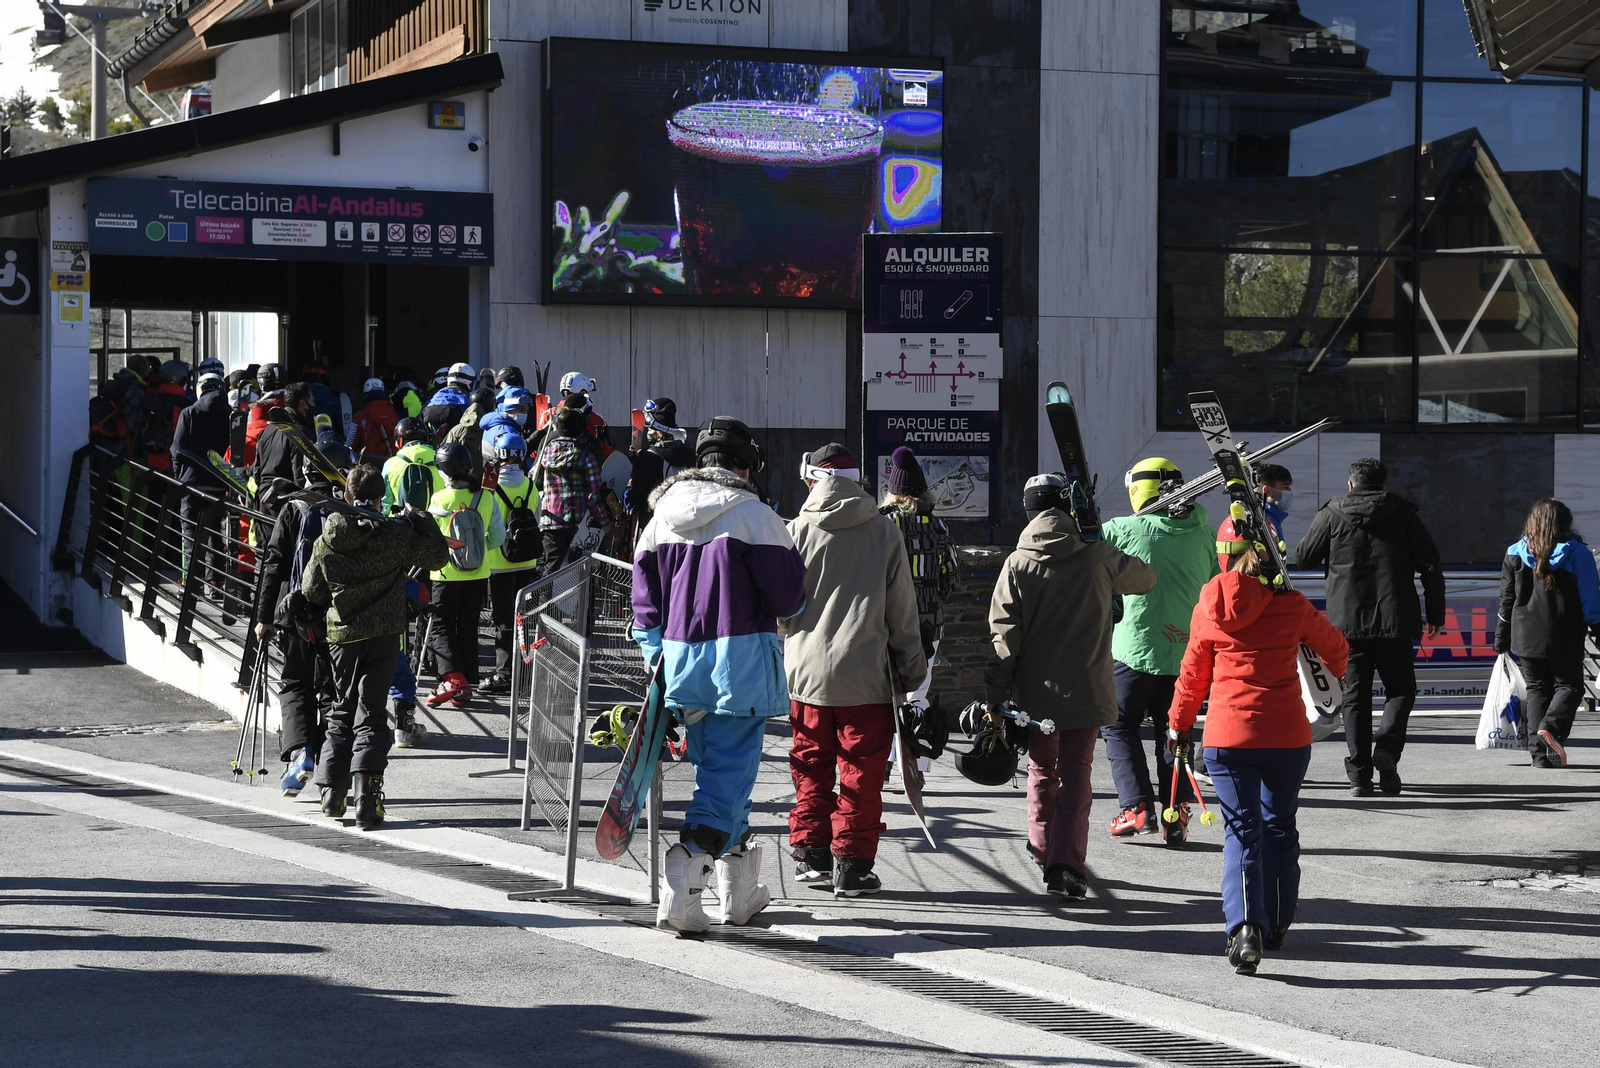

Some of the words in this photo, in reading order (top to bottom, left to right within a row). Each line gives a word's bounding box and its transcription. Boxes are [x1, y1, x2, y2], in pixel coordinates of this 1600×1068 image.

[170, 189, 293, 213] Telecabina
[293, 194, 424, 217] Al-Andalus
[220, 221, 240, 229] bajada
[885, 247, 990, 265] ALQUILER
[885, 263, 913, 274] ESQUÍ
[926, 264, 990, 273] SNOWBOARD
[1196, 411, 1225, 422] CUP
[887, 418, 946, 431] PARQUE
[950, 418, 969, 429] DE
[905, 432, 990, 442] ACTIVIDADES
[1299, 643, 1330, 692] EAD
